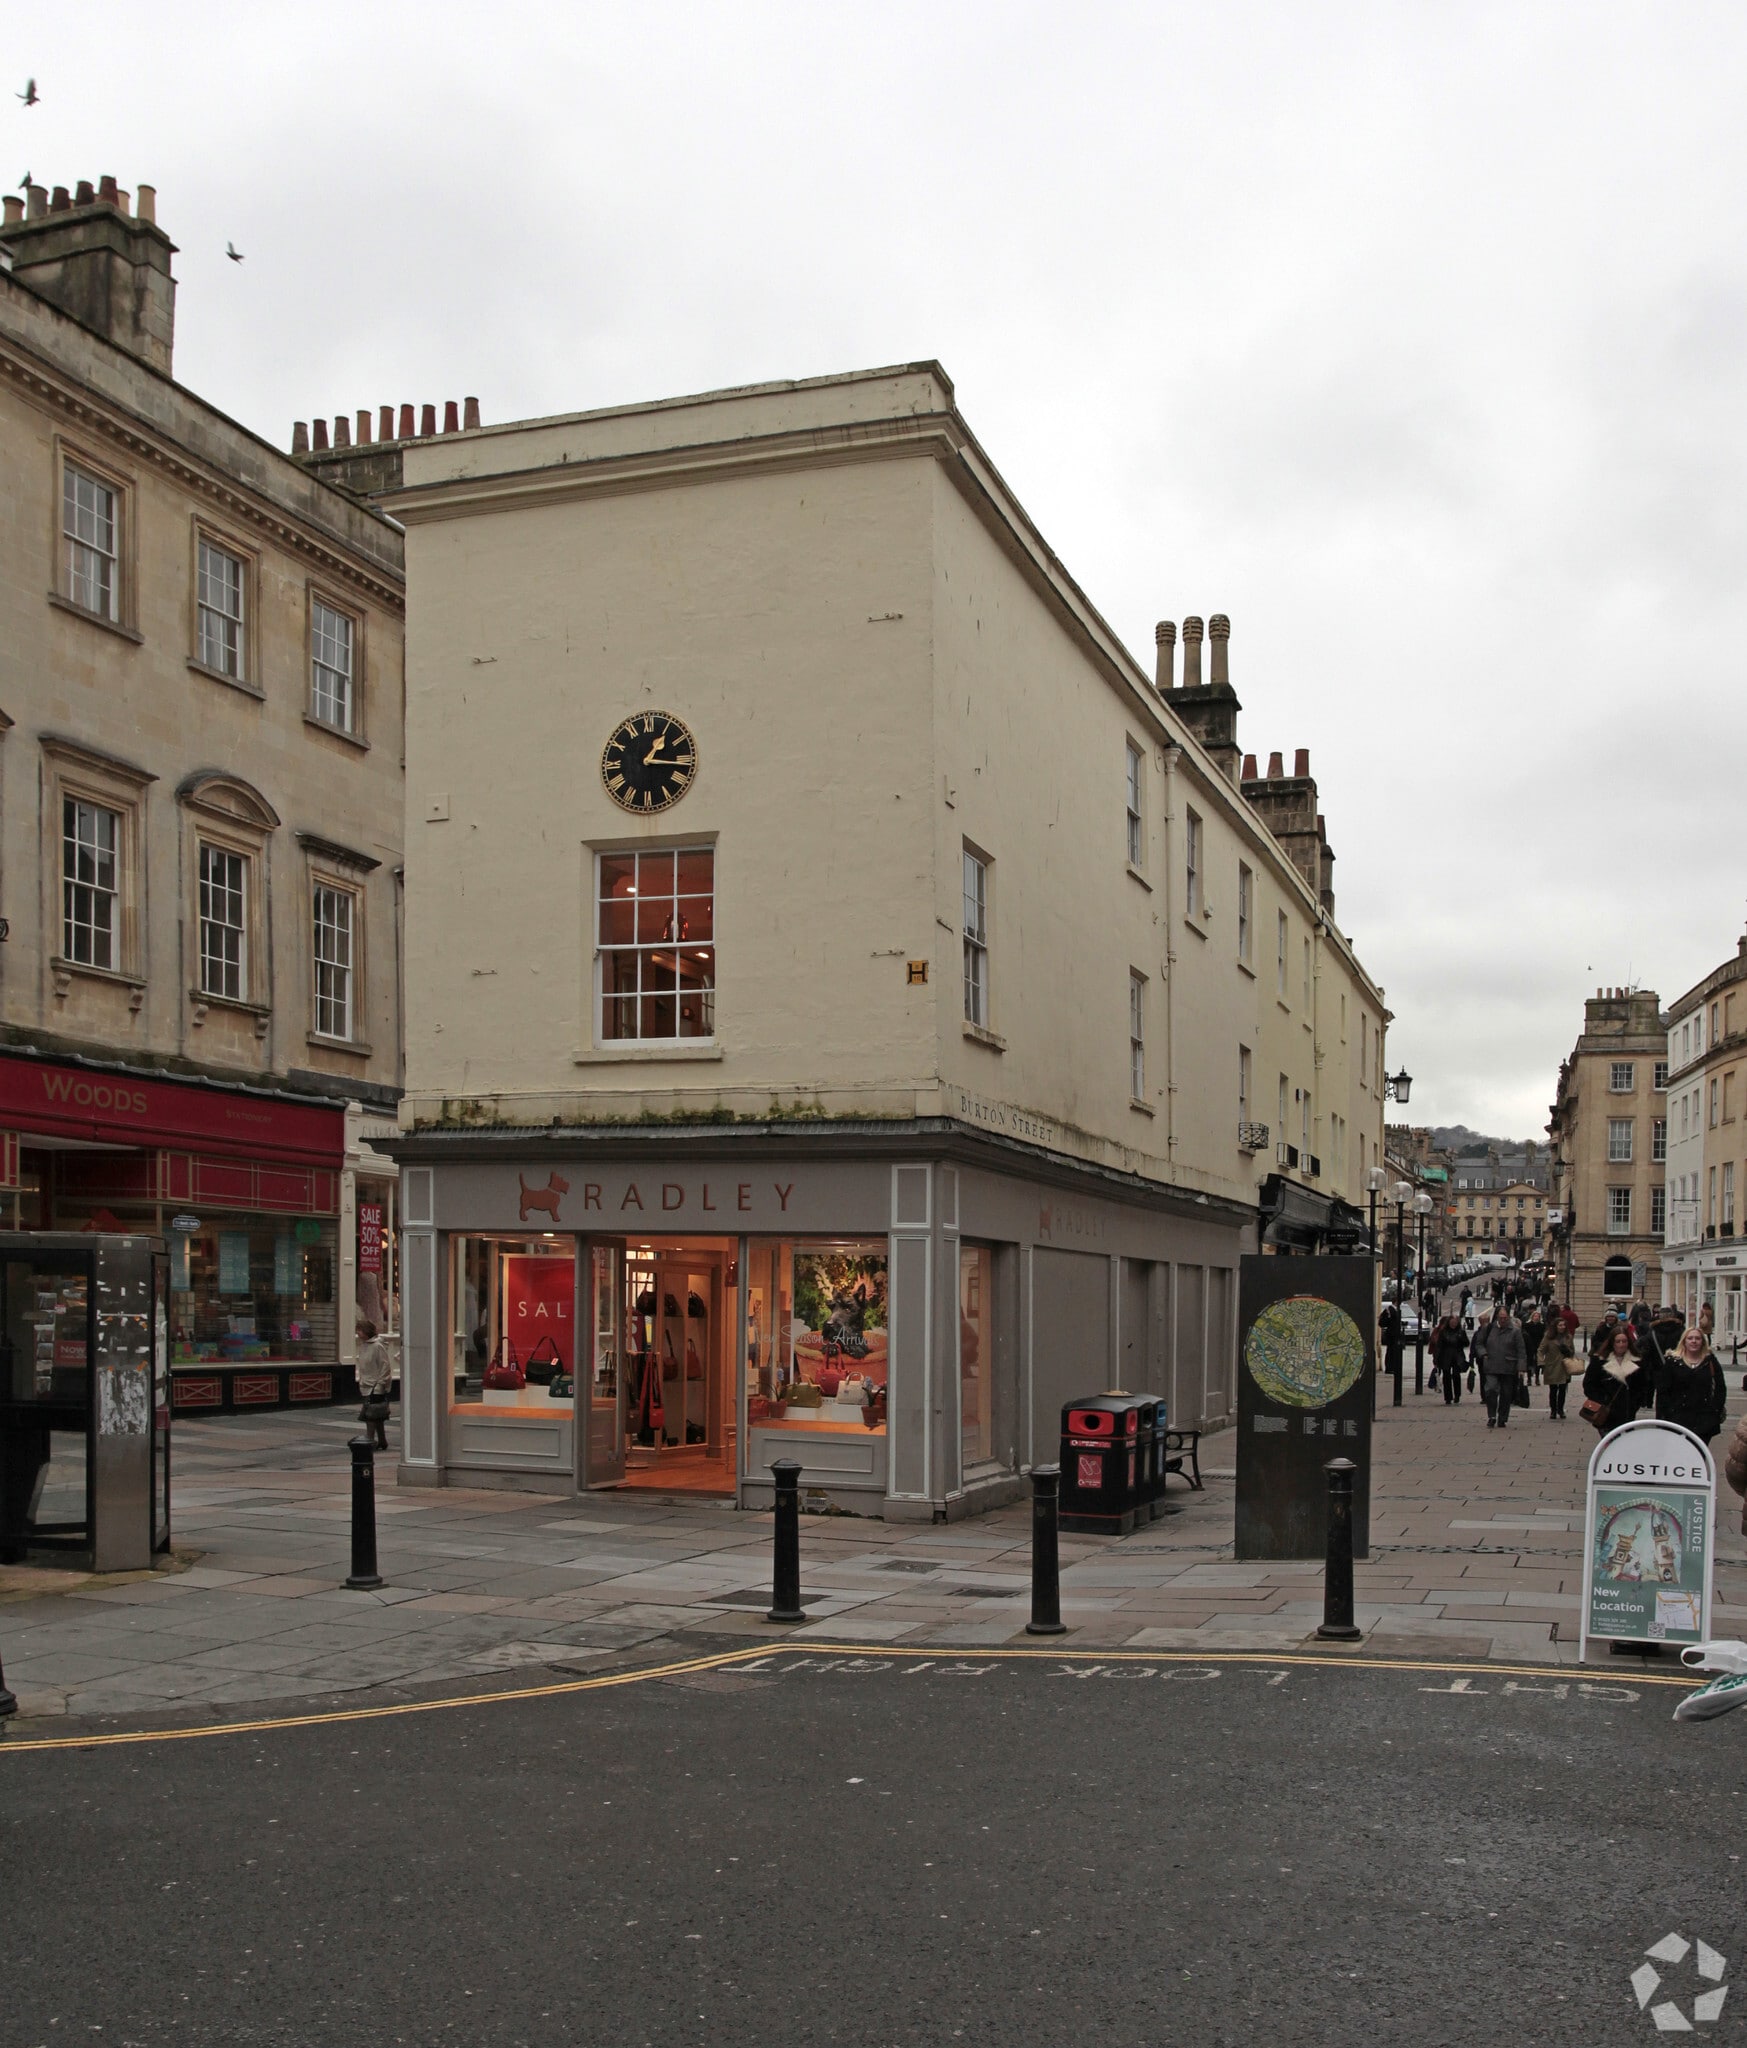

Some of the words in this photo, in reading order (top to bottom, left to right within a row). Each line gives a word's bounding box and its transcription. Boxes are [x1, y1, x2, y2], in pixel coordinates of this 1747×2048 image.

[960, 1095, 1006, 1126] BURTON
[1012, 1113, 1053, 1142] STREET
[583, 1182, 795, 1212] RADLEY
[361, 1208, 381, 1224] SALE
[361, 1226, 380, 1244] 50%
[361, 1246, 380, 1256] OFF
[518, 1301, 567, 1318] SAL
[1603, 1463, 1702, 1478] JUSTICE
[1691, 1498, 1704, 1553] JUSTICE
[1593, 1586, 1620, 1597] New
[1592, 1600, 1645, 1613] Location
